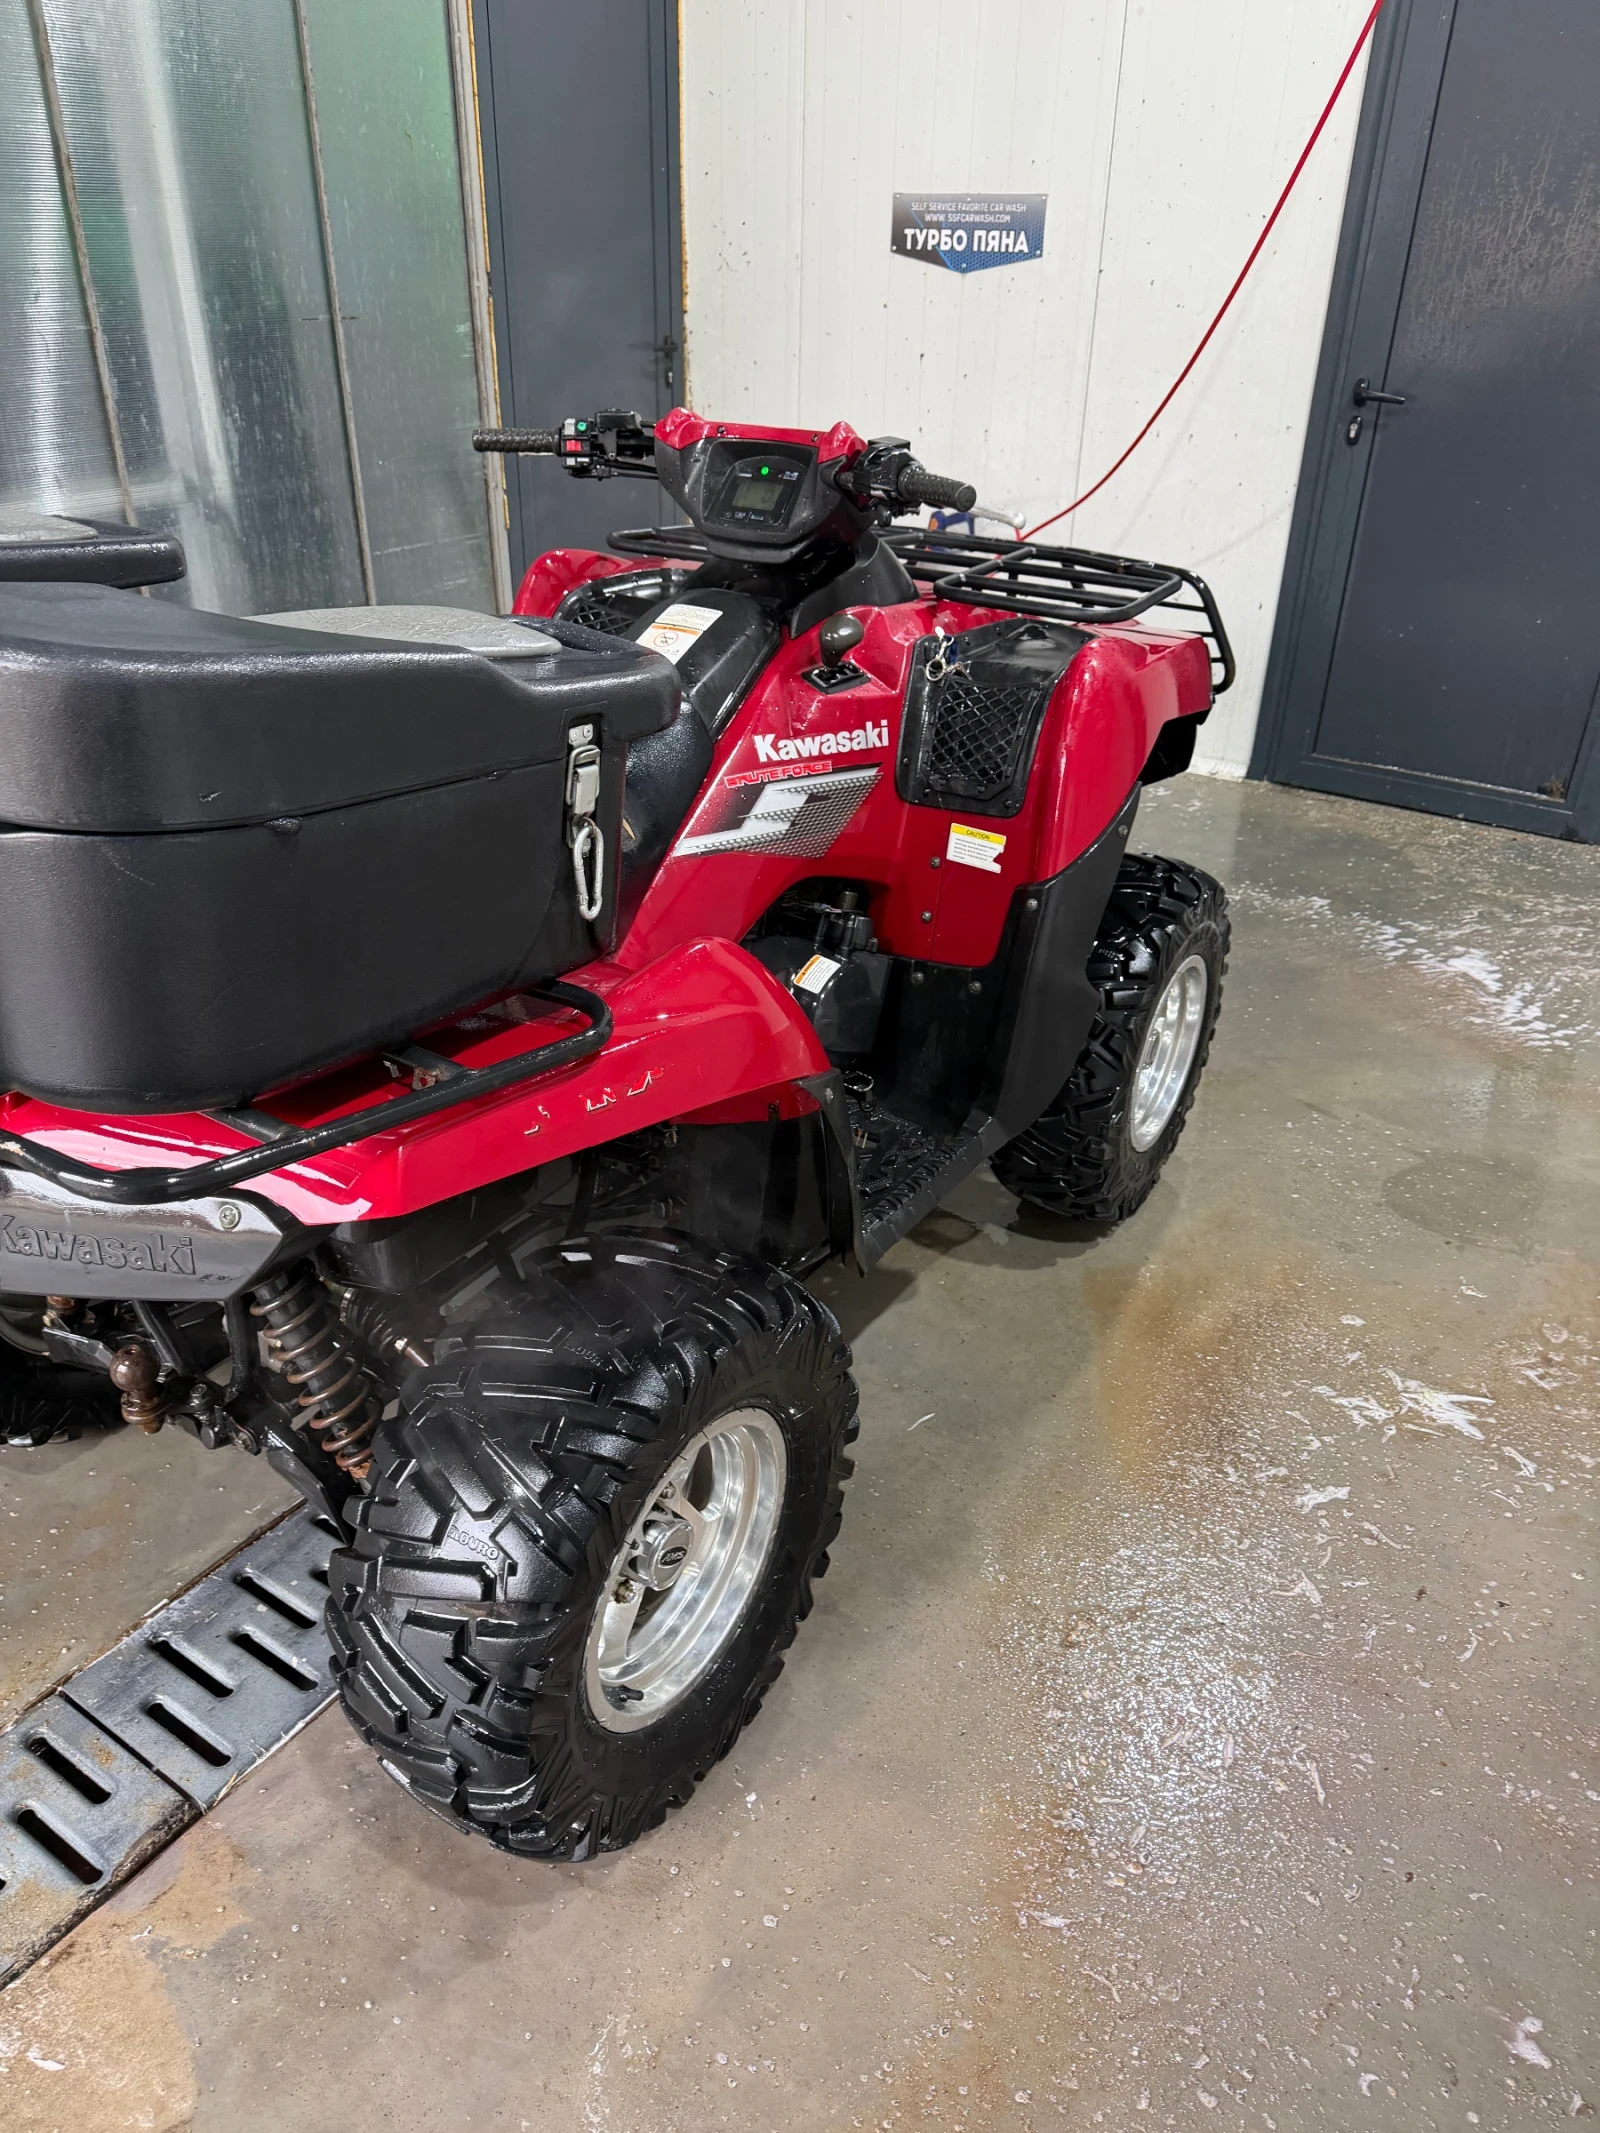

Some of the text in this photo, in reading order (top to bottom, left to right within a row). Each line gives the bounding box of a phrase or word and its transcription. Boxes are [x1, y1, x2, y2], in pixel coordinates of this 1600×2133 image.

[911, 202, 1027, 213] SELF SERVICE FAVORITE CAR WASH
[903, 228, 1029, 253] ТУРБО ПЯНА
[753, 719, 889, 763] Kawasaki
[965, 829, 990, 840] CAUTION
